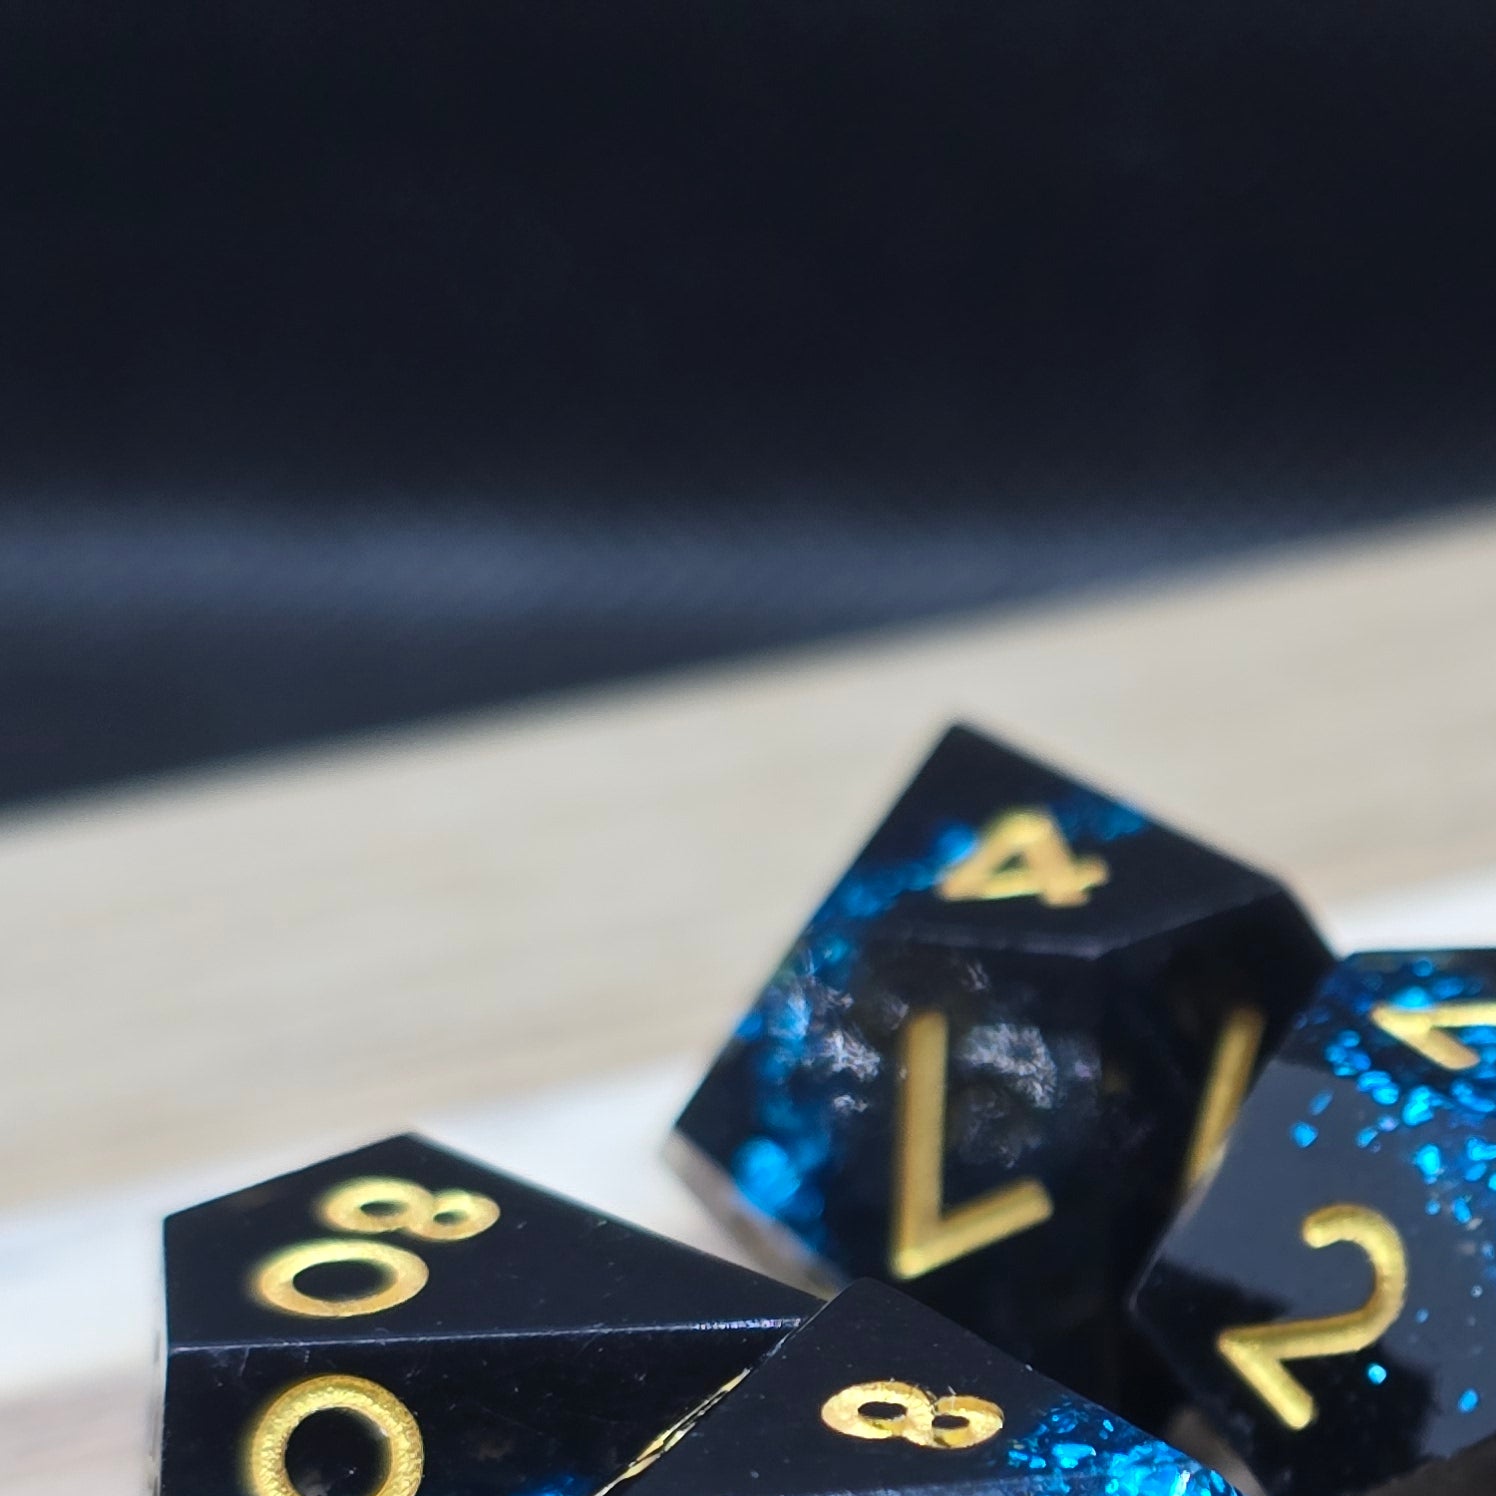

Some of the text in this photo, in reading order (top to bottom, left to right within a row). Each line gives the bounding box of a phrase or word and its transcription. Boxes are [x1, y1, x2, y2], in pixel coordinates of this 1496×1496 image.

[938, 808, 1109, 906] 4
[892, 1009, 1053, 1279] 7
[1217, 1204, 1408, 1430] 2
[820, 1379, 1005, 1449] 8
